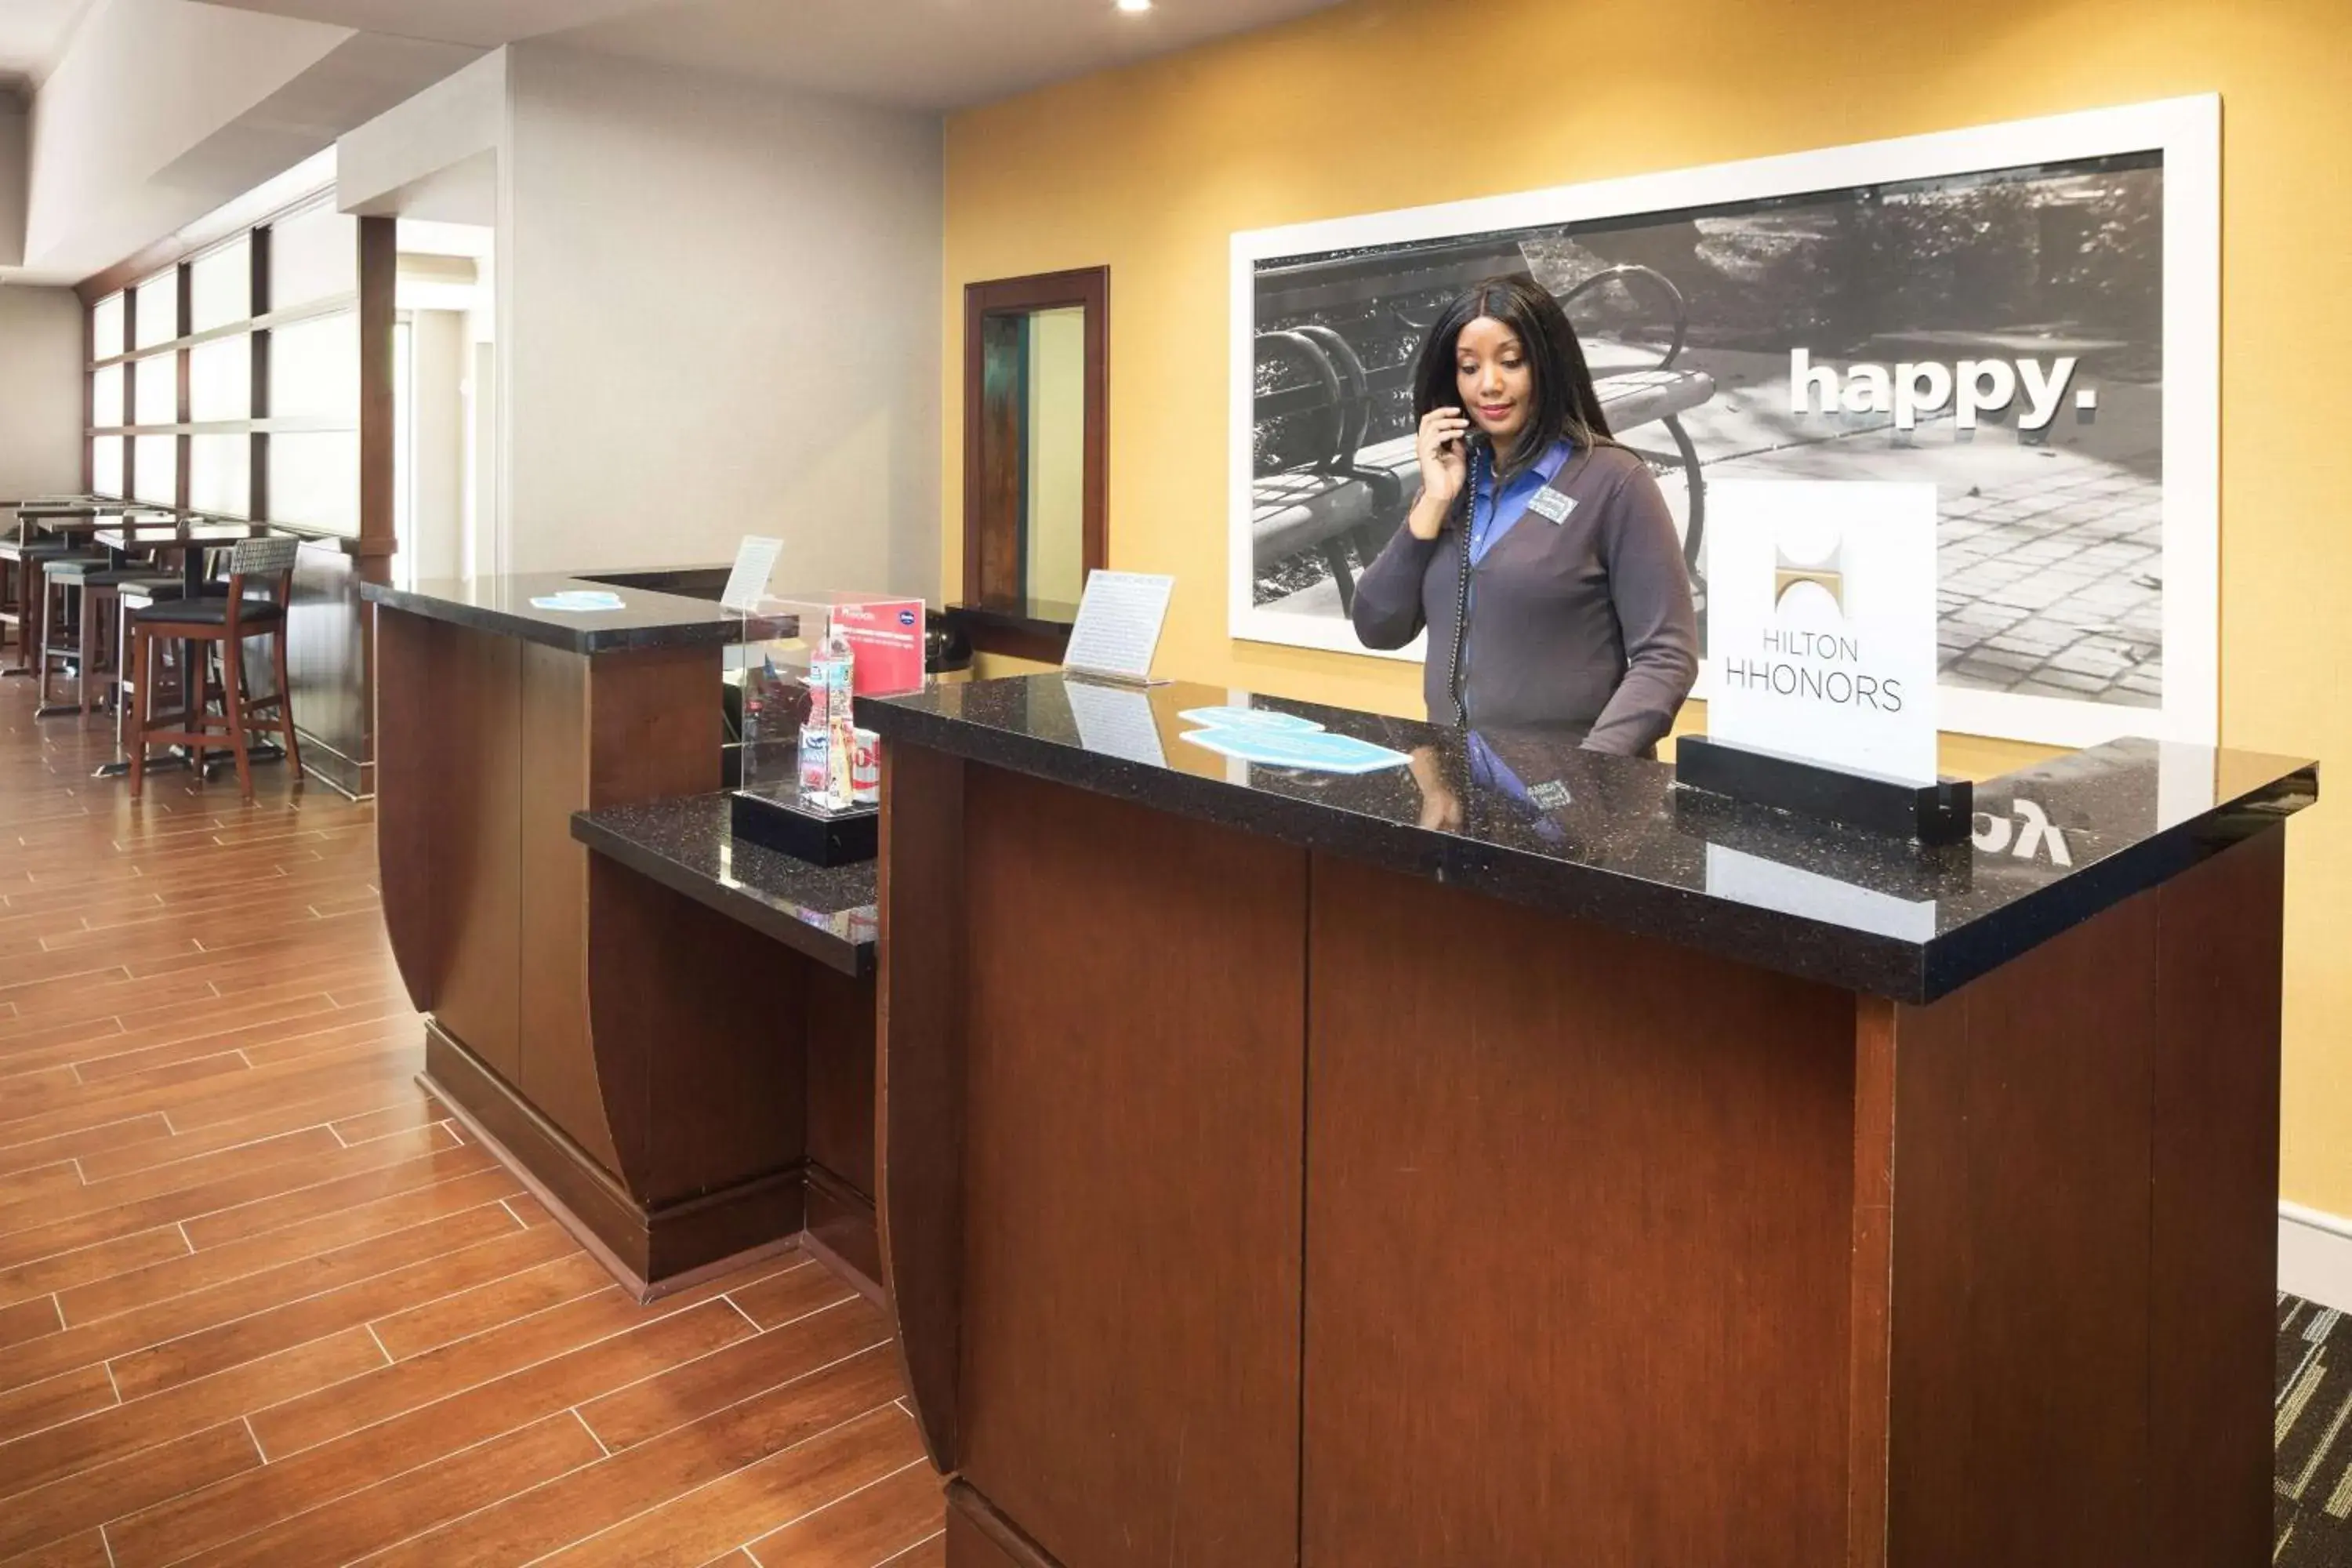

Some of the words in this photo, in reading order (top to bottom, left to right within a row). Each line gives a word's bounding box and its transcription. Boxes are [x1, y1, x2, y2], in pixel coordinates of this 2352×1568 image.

[1791, 347, 2097, 430] happy.
[1763, 628, 1857, 662] HILTON
[1726, 656, 1902, 712] HHONORS
